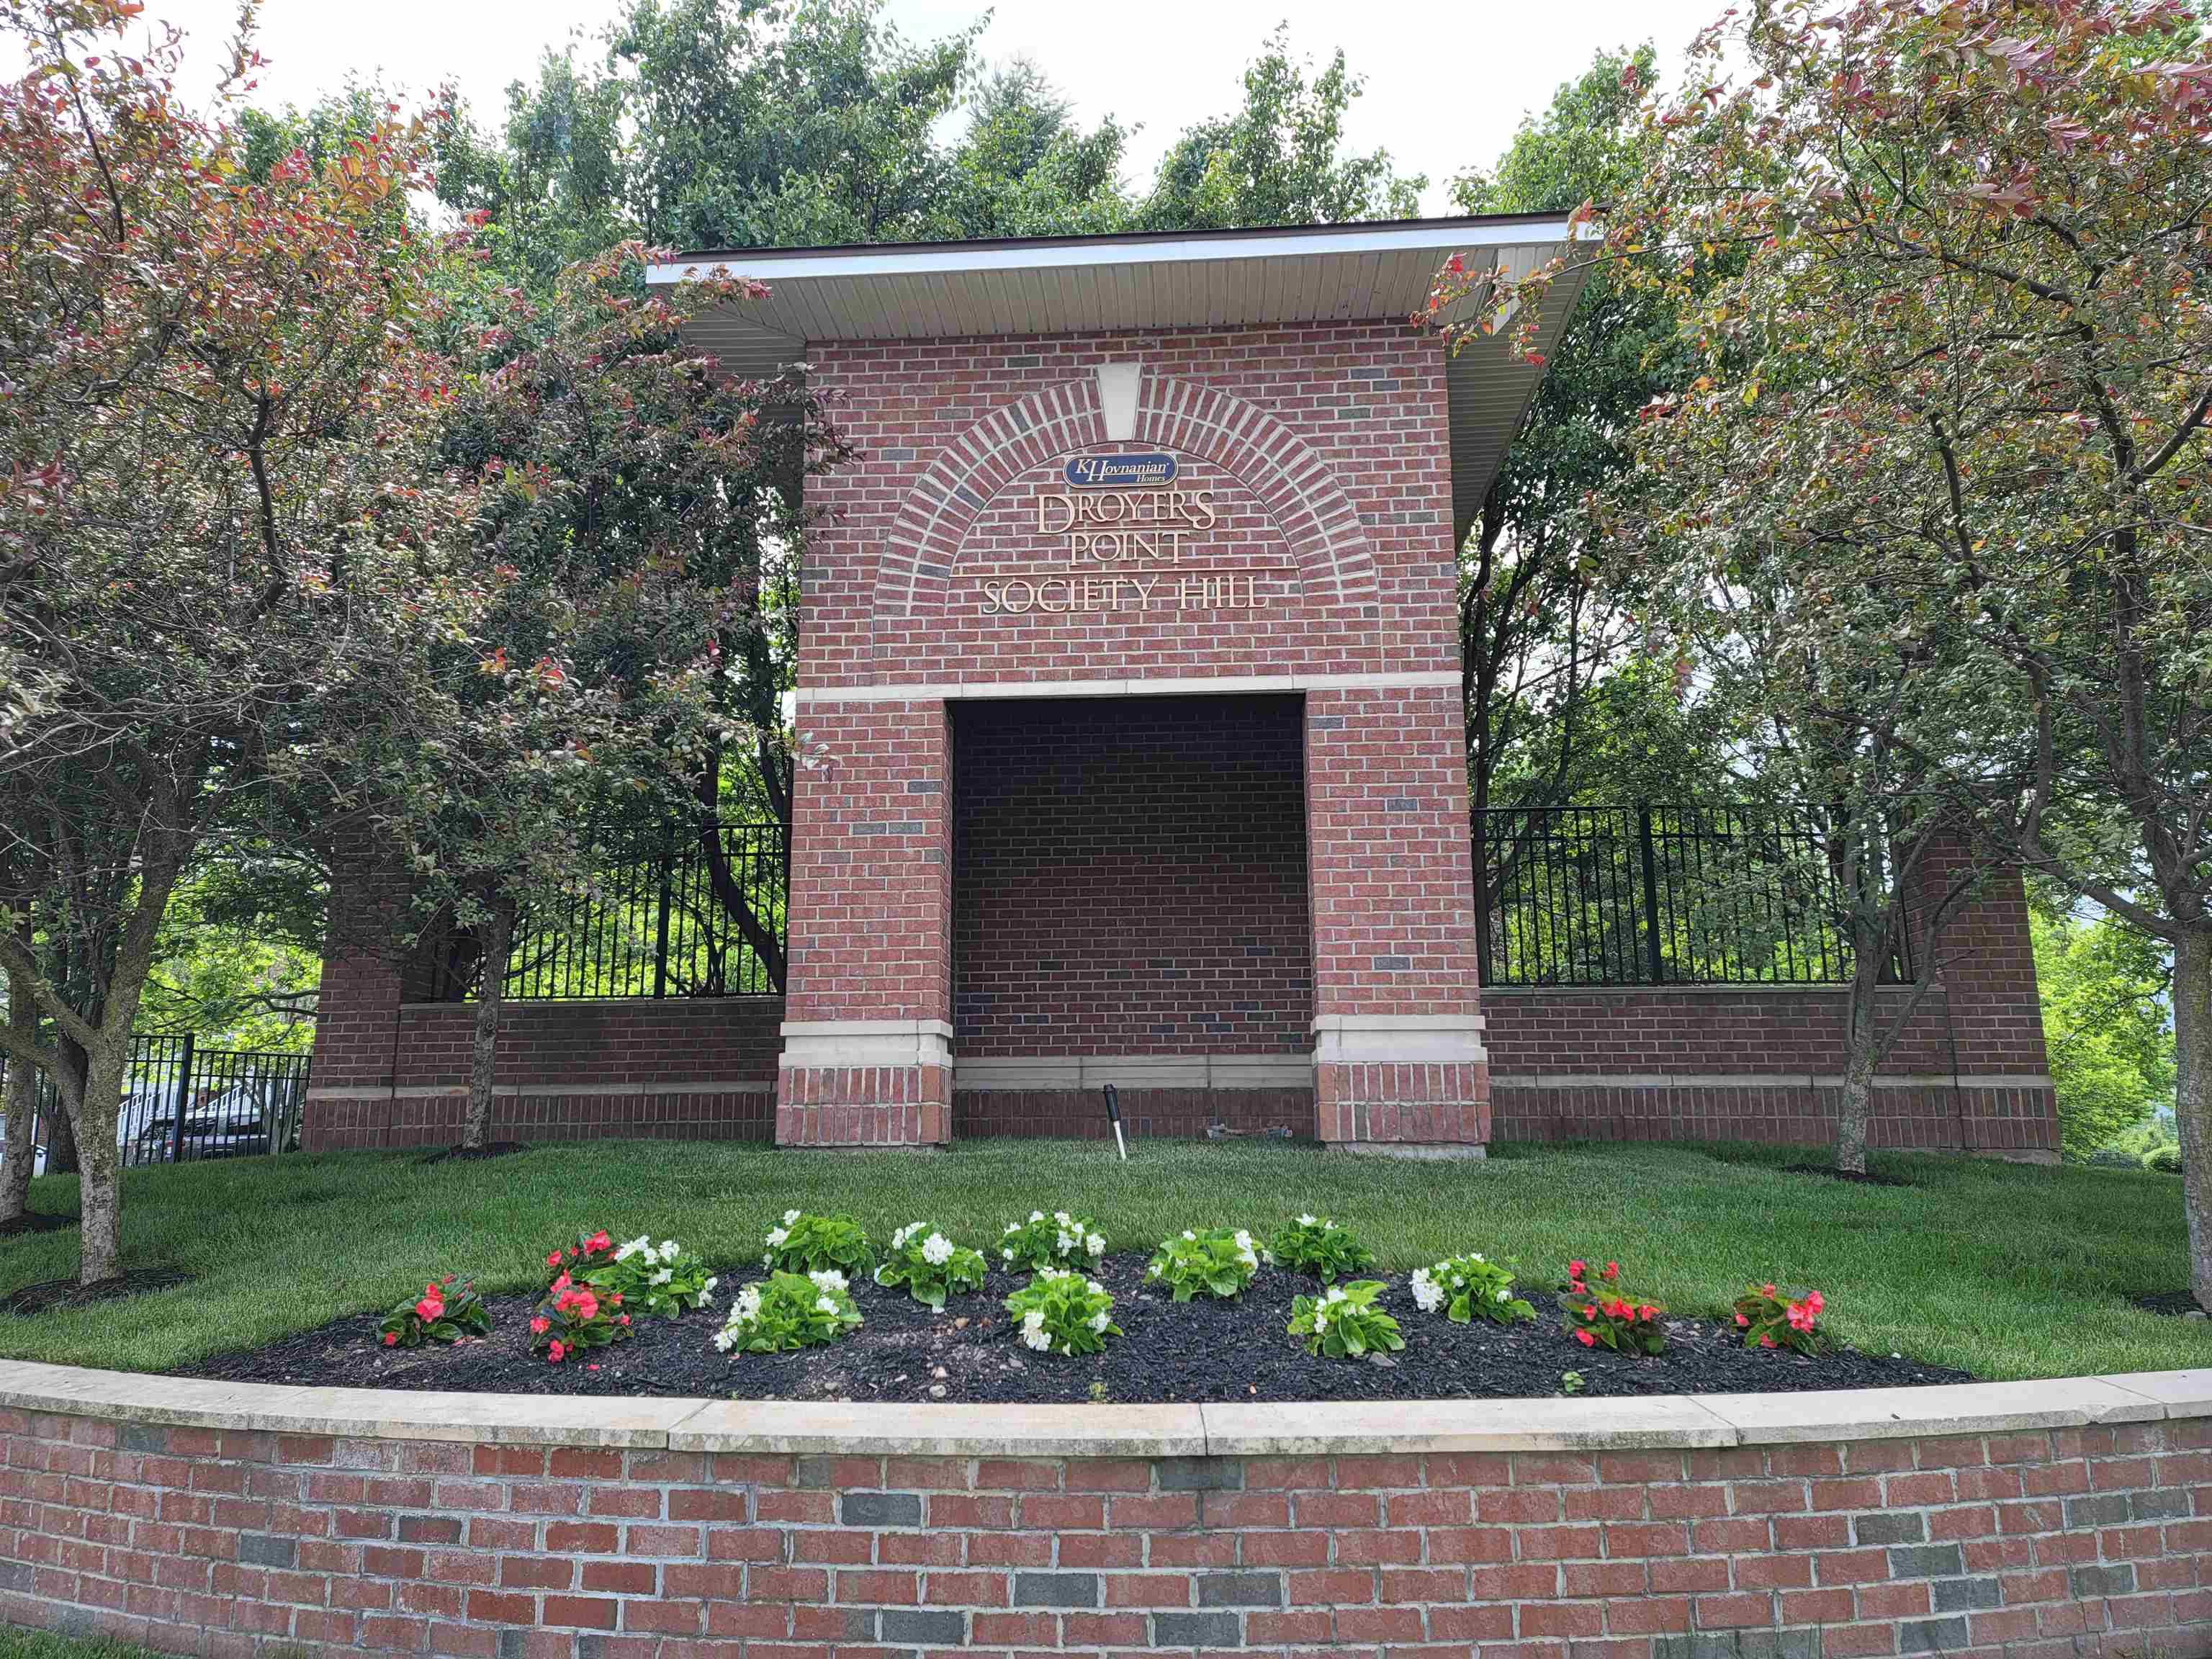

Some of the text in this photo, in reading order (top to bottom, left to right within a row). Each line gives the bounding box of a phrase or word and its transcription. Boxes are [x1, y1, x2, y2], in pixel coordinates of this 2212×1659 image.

[1037, 491, 1215, 534] DROYERS
[1069, 531, 1190, 567] POINT
[982, 576, 1269, 614] SOCIETY HILL
